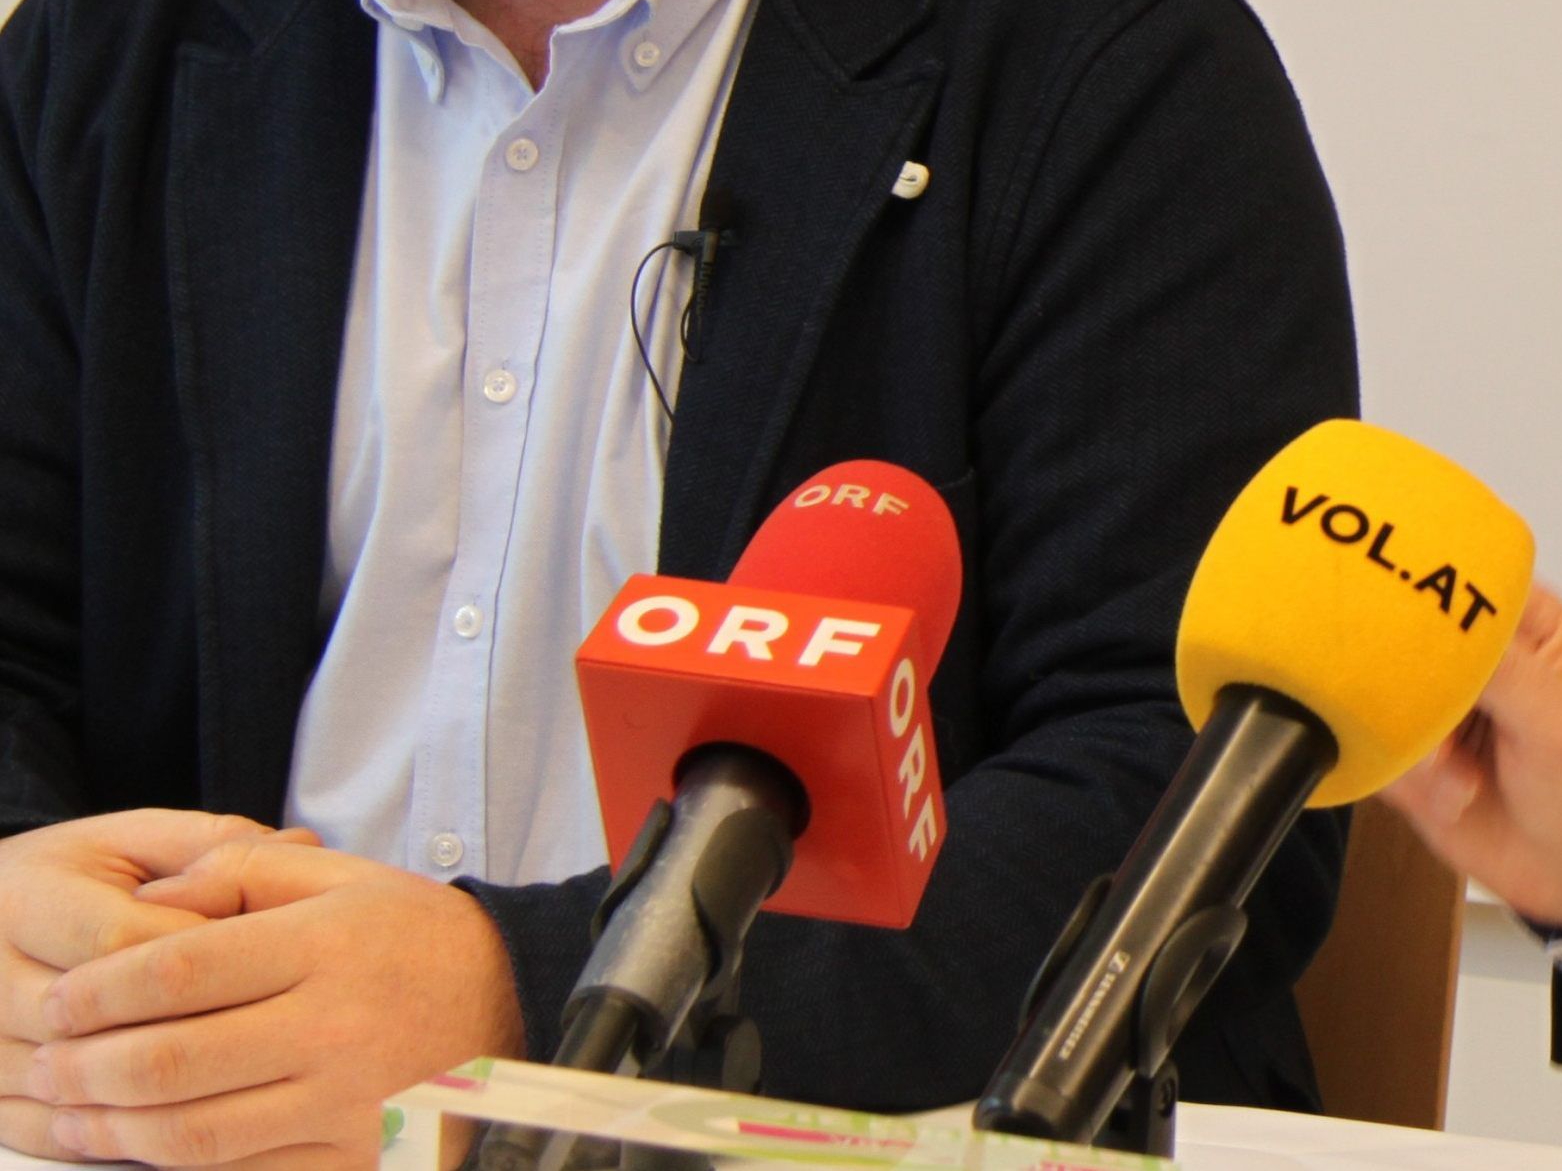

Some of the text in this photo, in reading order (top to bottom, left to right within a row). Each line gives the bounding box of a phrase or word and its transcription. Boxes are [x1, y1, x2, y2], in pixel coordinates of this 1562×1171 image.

[793, 483, 910, 516] ORF
[1280, 485, 1498, 634] VOL.AT
[616, 594, 882, 667] ORF
[888, 657, 937, 863] ORF
